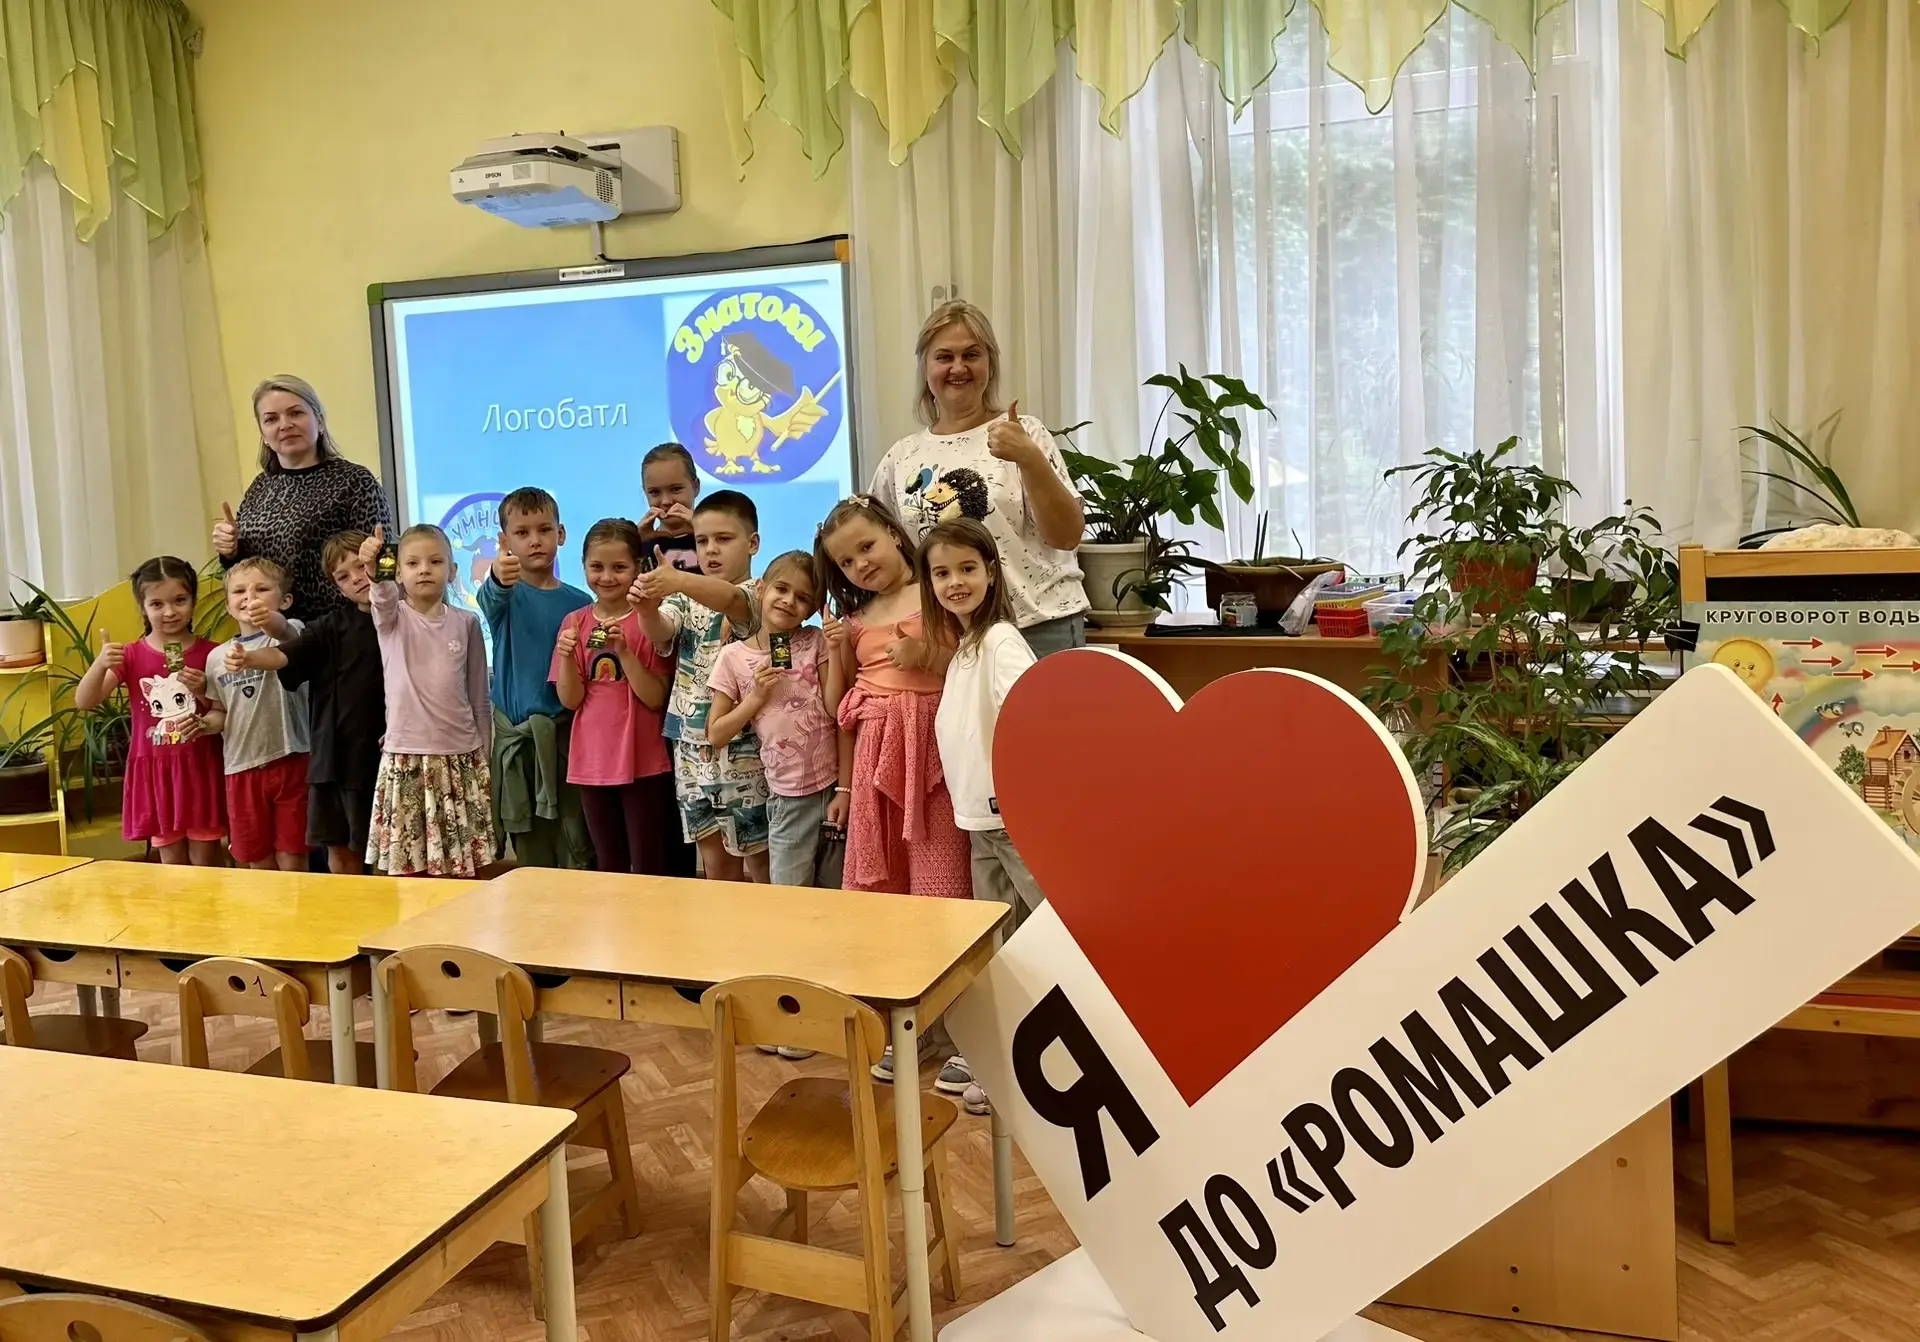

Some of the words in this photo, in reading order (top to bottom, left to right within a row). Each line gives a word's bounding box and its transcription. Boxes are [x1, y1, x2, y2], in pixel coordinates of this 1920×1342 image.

[674, 292, 827, 364] Знатоки
[482, 397, 628, 433] Логобатл
[1706, 610, 1850, 624] КРУГОВОРОТ
[253, 976, 267, 997] 1
[1158, 1174, 1277, 1332] ДО
[1266, 795, 1776, 1214] «РОМАШКА»
[1012, 983, 1160, 1201] Я
